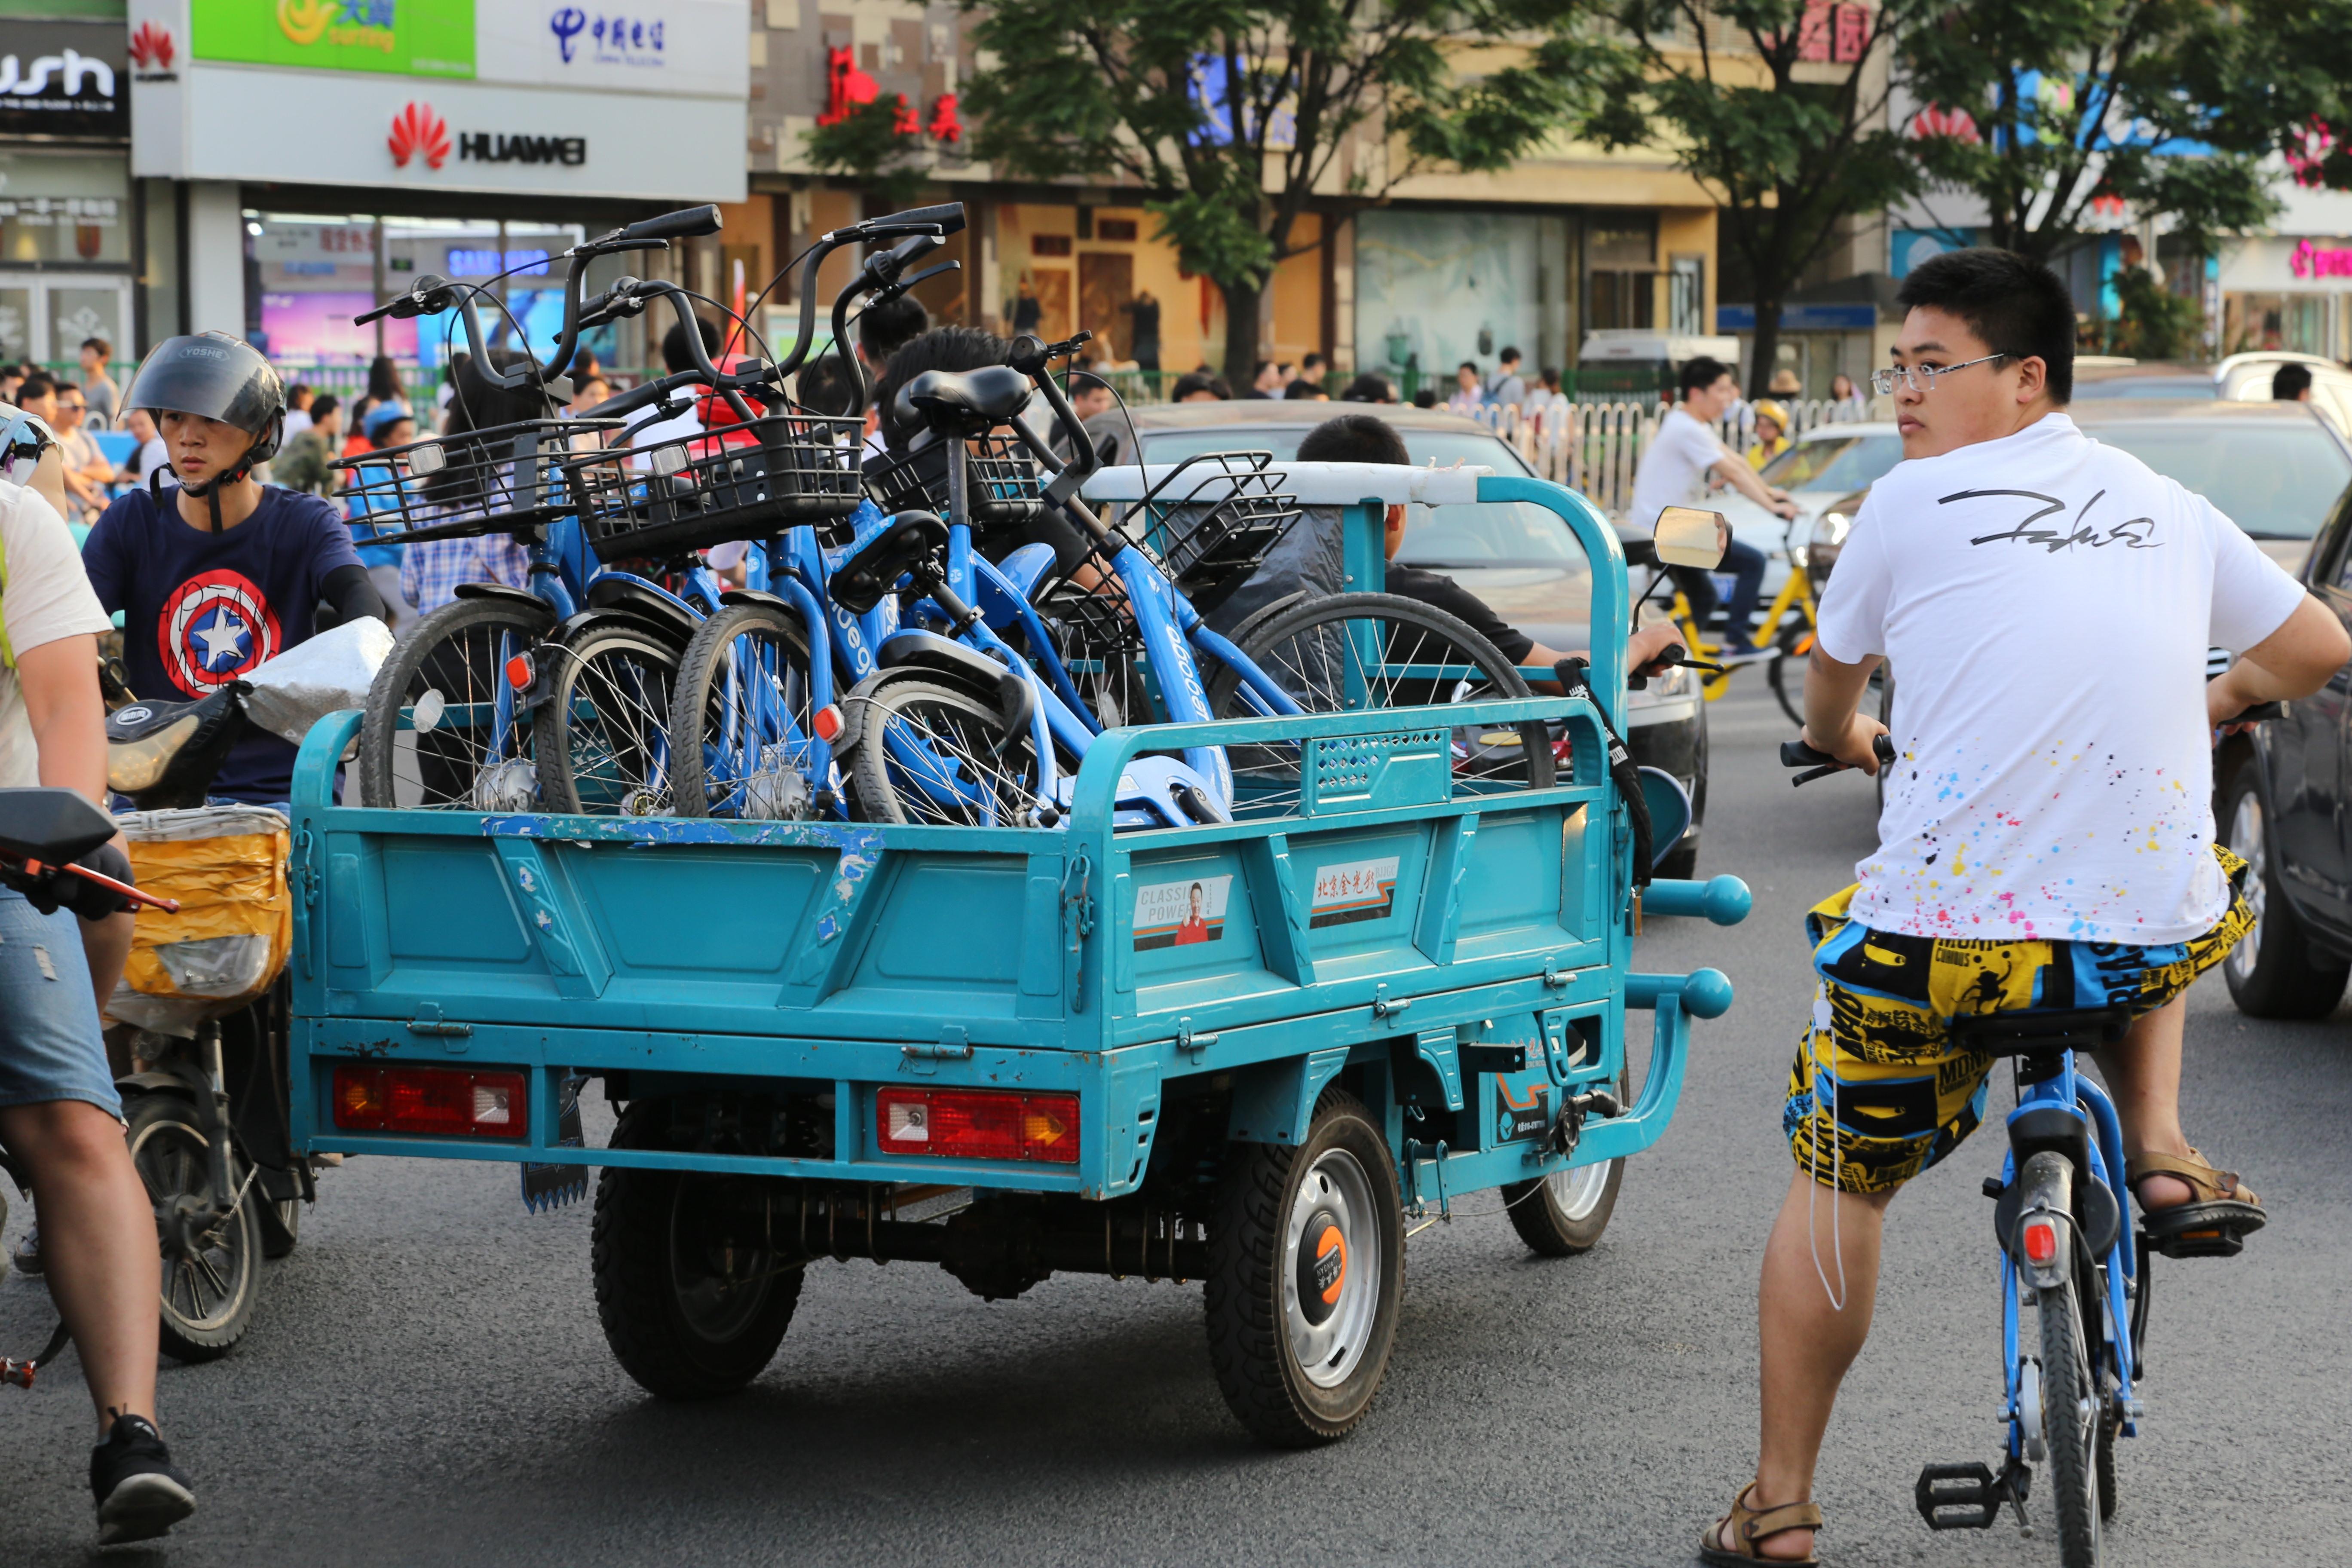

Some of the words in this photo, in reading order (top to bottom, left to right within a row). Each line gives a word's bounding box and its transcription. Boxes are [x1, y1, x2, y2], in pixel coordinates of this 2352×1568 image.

[592, 17, 664, 51] 中国电信
[460, 132, 586, 165] HUAWEI
[187, 348, 223, 358] YOSHE
[1318, 869, 1375, 898] 北京金光彩
[1376, 865, 1396, 878] BJJGC
